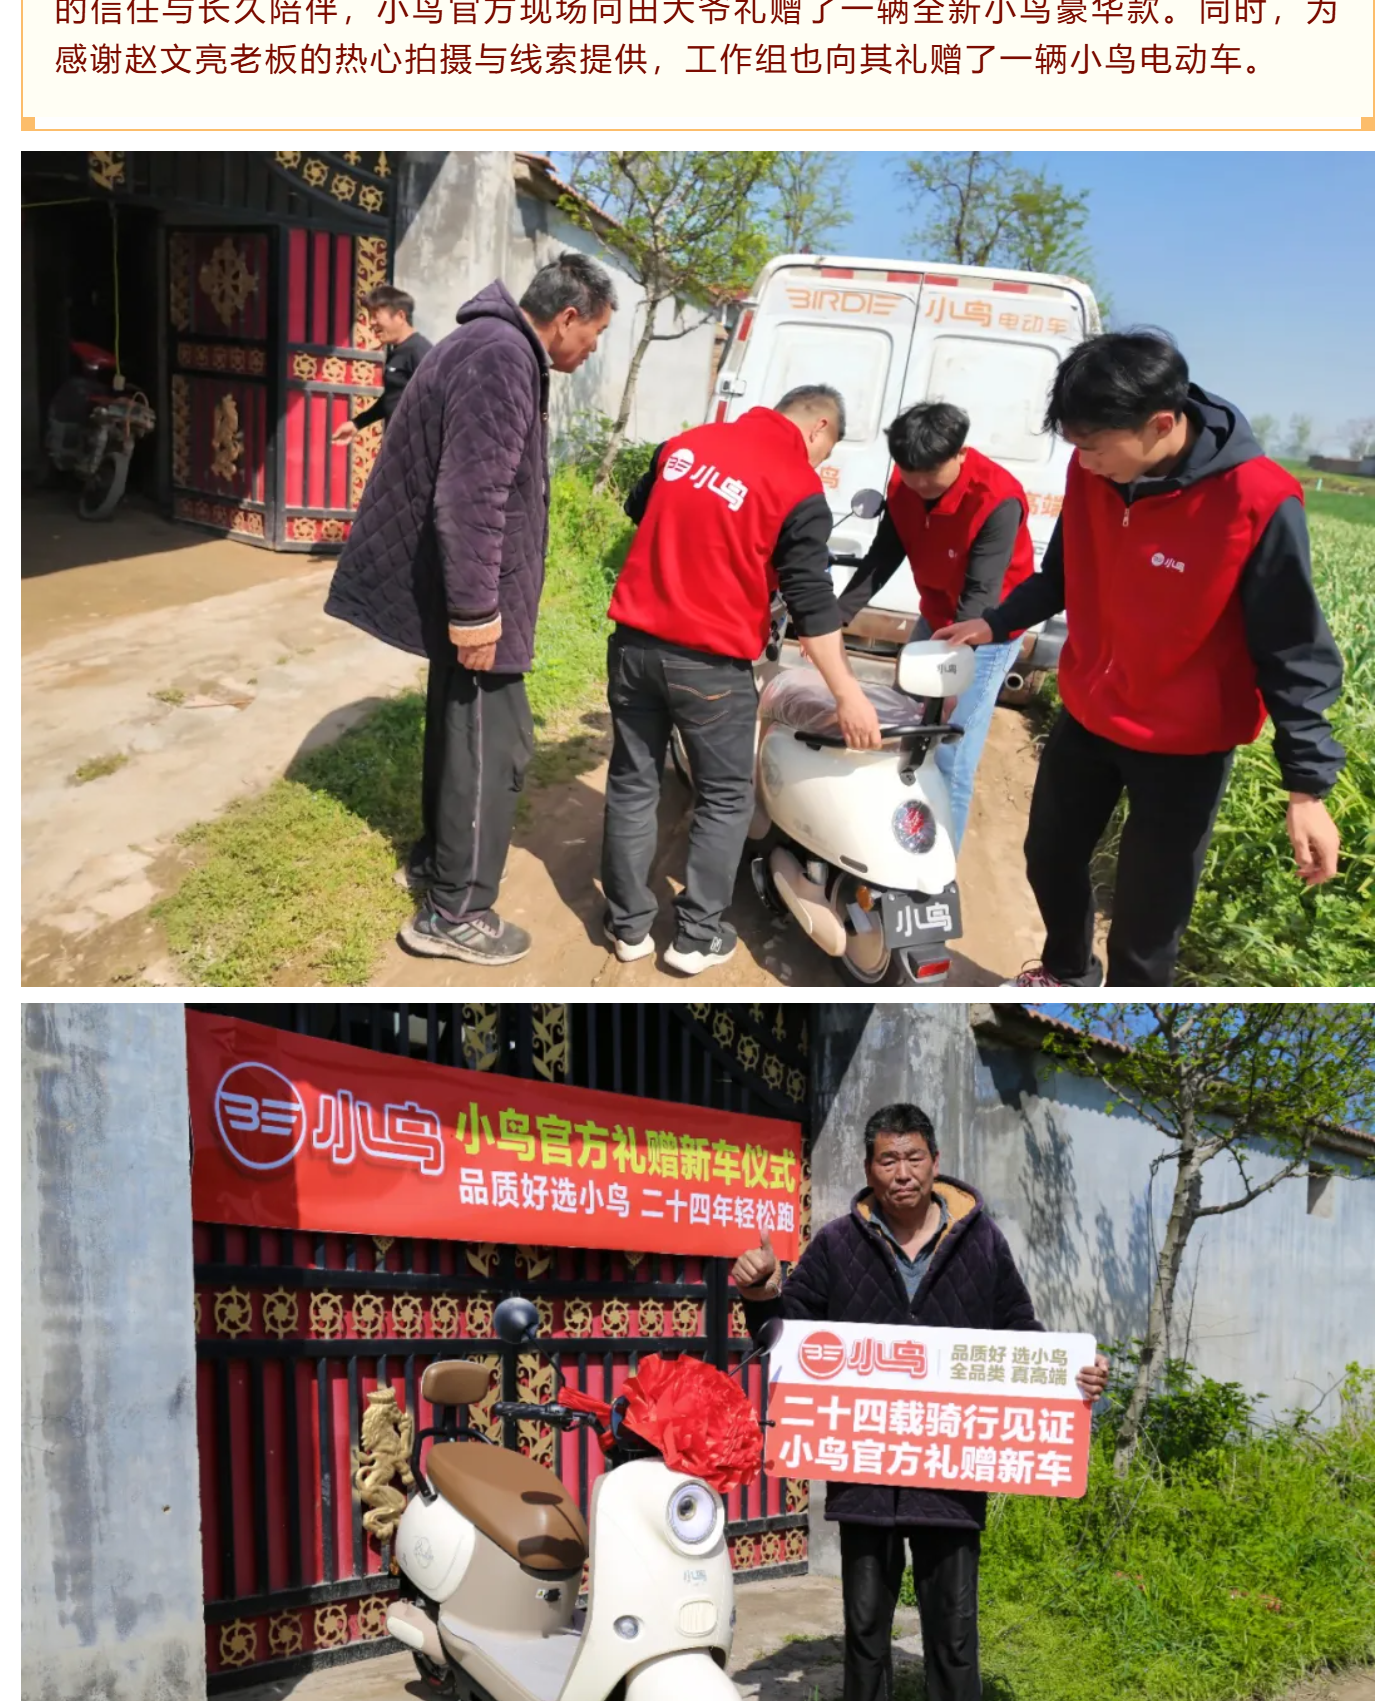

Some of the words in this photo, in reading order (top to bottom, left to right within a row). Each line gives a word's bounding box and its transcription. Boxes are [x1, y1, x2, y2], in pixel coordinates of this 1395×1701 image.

[785, 288, 901, 316] BIRDIE
[924, 295, 992, 327] 小鸟
[998, 313, 1071, 335] 电动车
[689, 464, 749, 512] 小鸟
[895, 901, 953, 937] 小鸟
[312, 1089, 446, 1176] 小鸟
[455, 1102, 797, 1193] 小鸟官方礼赠新车仪式
[458, 1167, 631, 1218] 品质好选小鸟
[641, 1188, 796, 1234] 二十四年轻松跑
[848, 1336, 928, 1379] 小鸟
[950, 1343, 1007, 1363] 品质好
[1012, 1345, 1069, 1367] 选小鸟
[950, 1363, 1006, 1383] 全品类
[1010, 1365, 1068, 1386] 真高端
[780, 1395, 1075, 1445] 二十四载骑行见证
[778, 1434, 1073, 1488] 小鸟官方礼赠新车
